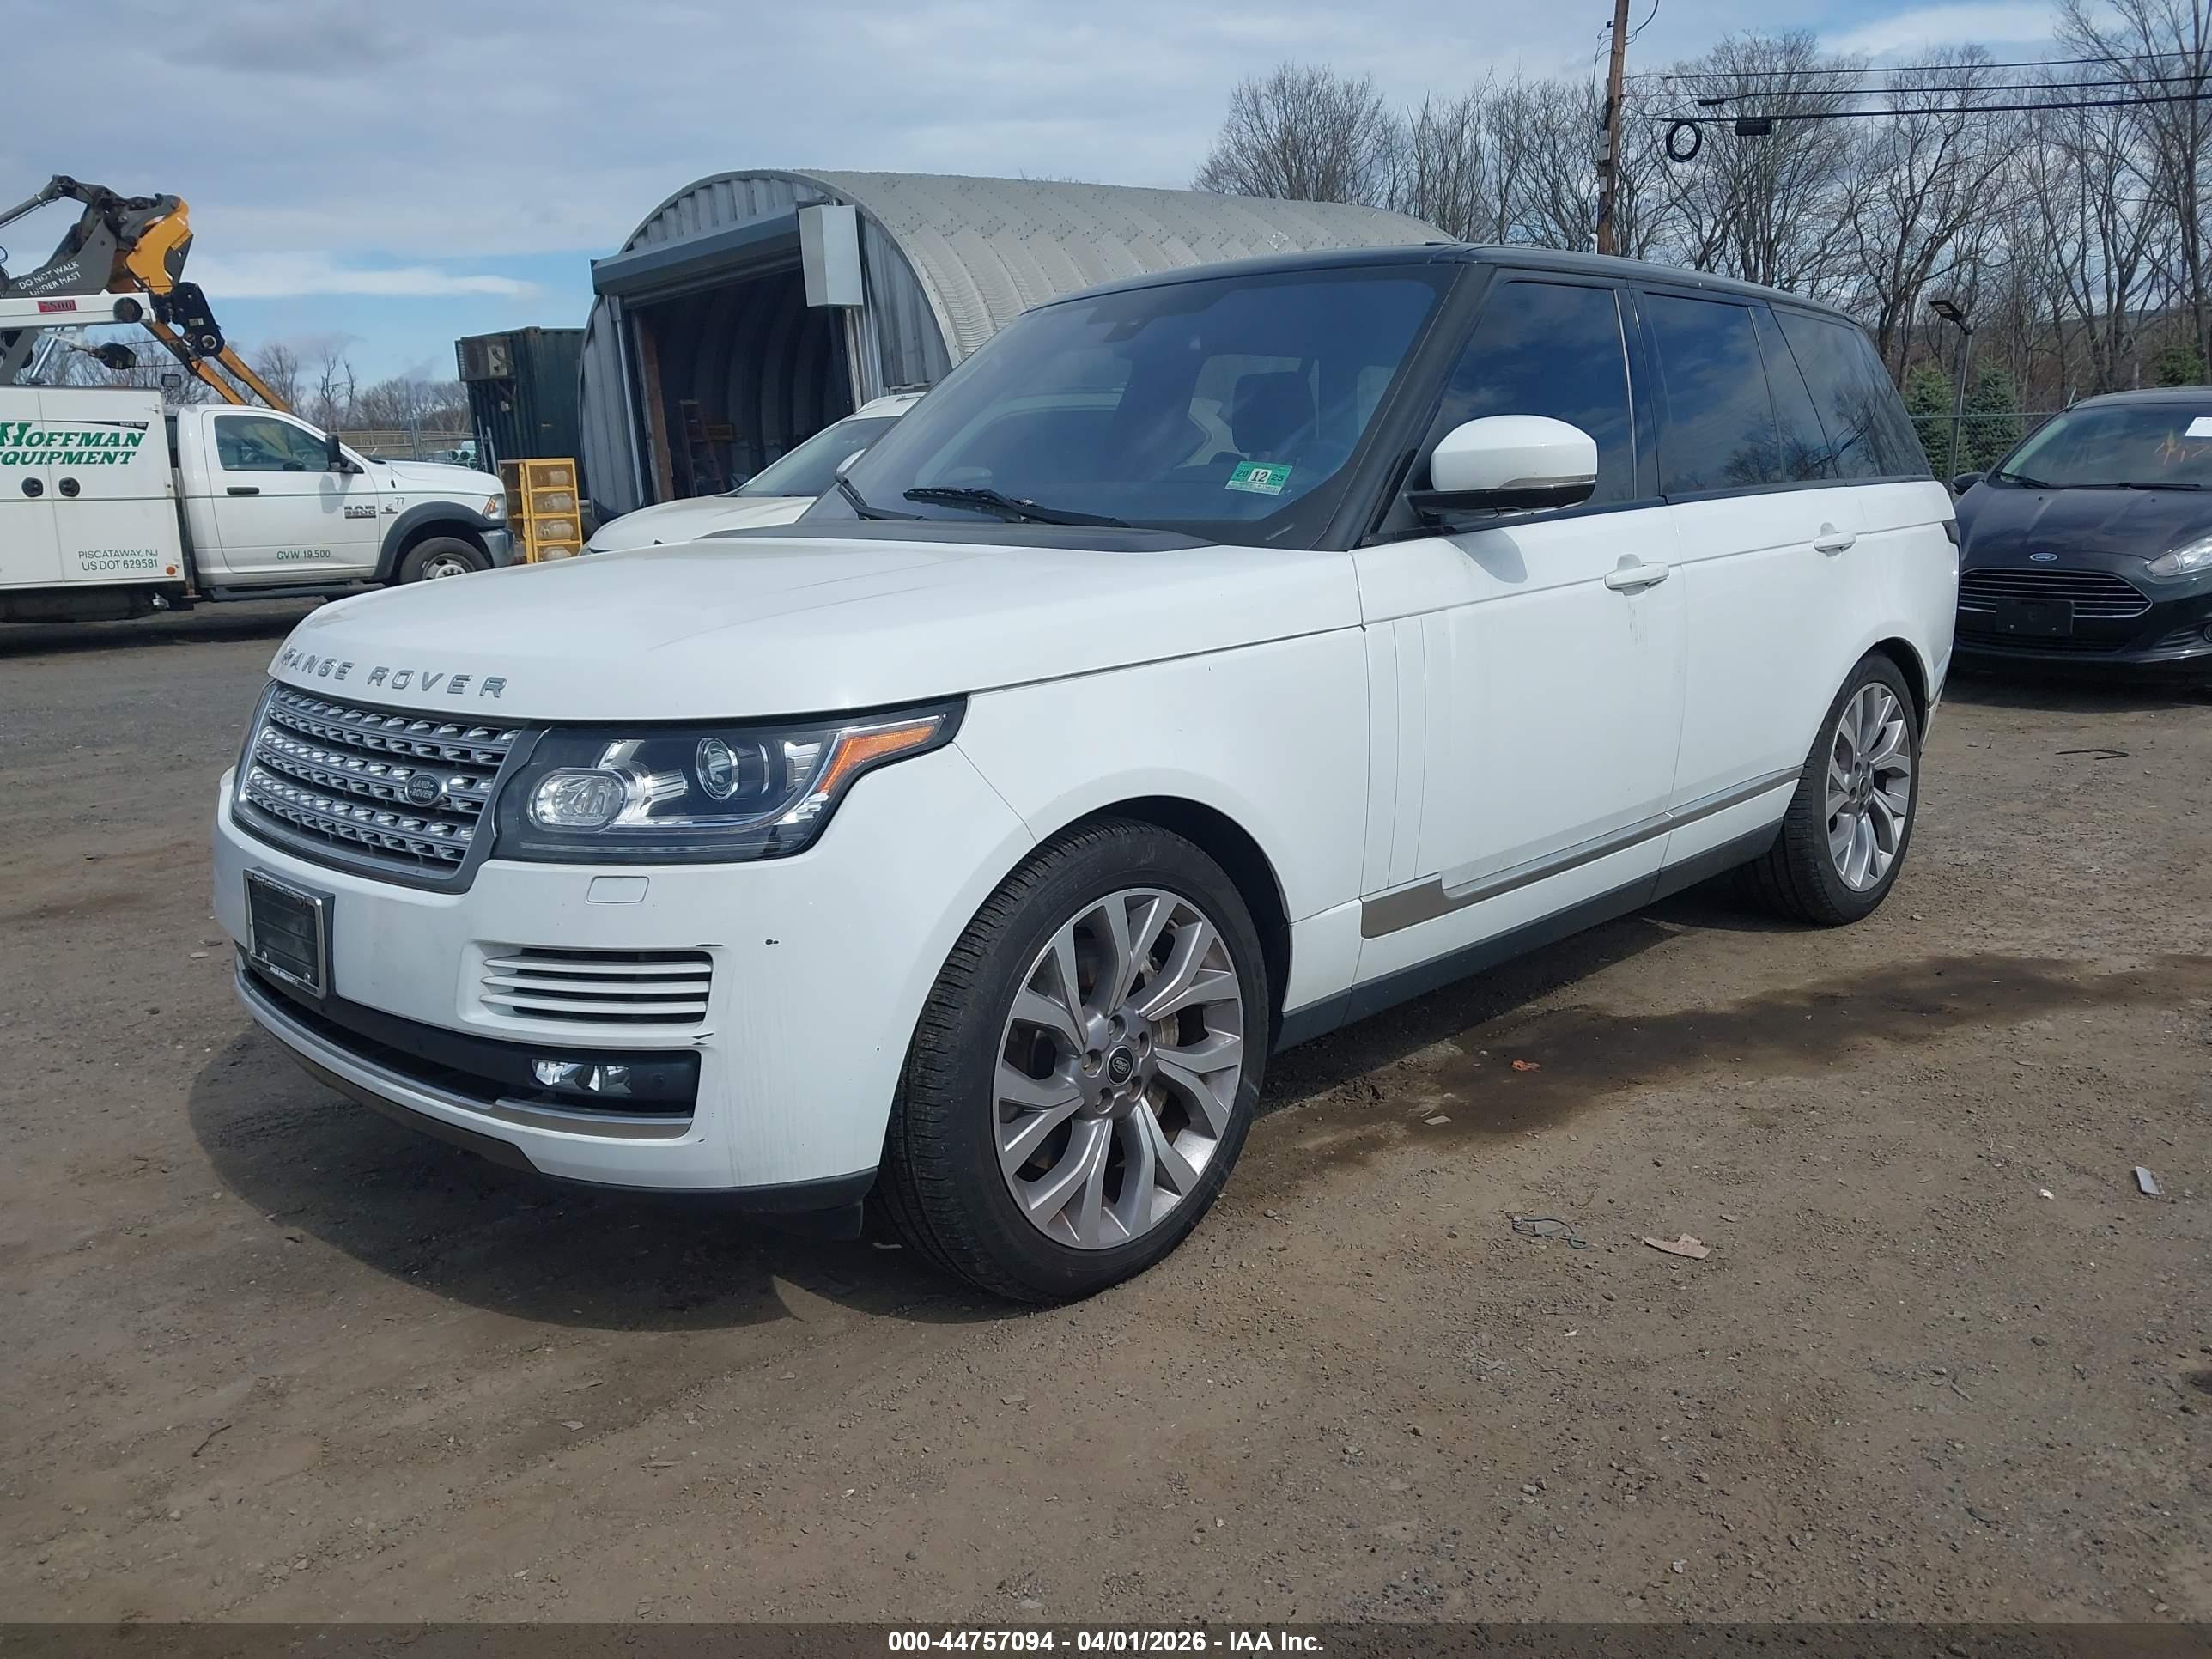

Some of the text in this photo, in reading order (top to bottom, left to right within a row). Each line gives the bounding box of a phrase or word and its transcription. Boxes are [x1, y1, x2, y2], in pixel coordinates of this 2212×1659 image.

[18, 260, 80, 289] DO NOT WALK
[29, 270, 82, 296] UNDER MAST
[0, 422, 145, 447] HOFFMAN
[0, 451, 137, 465] QUIPMENT
[1251, 471, 1268, 482] 12
[1271, 473, 1285, 482] 25
[78, 550, 143, 559] PISCATAWAY,
[276, 550, 300, 560] GVW
[82, 558, 158, 571] US DOT 629581
[281, 648, 507, 698] RANGE ROVER
